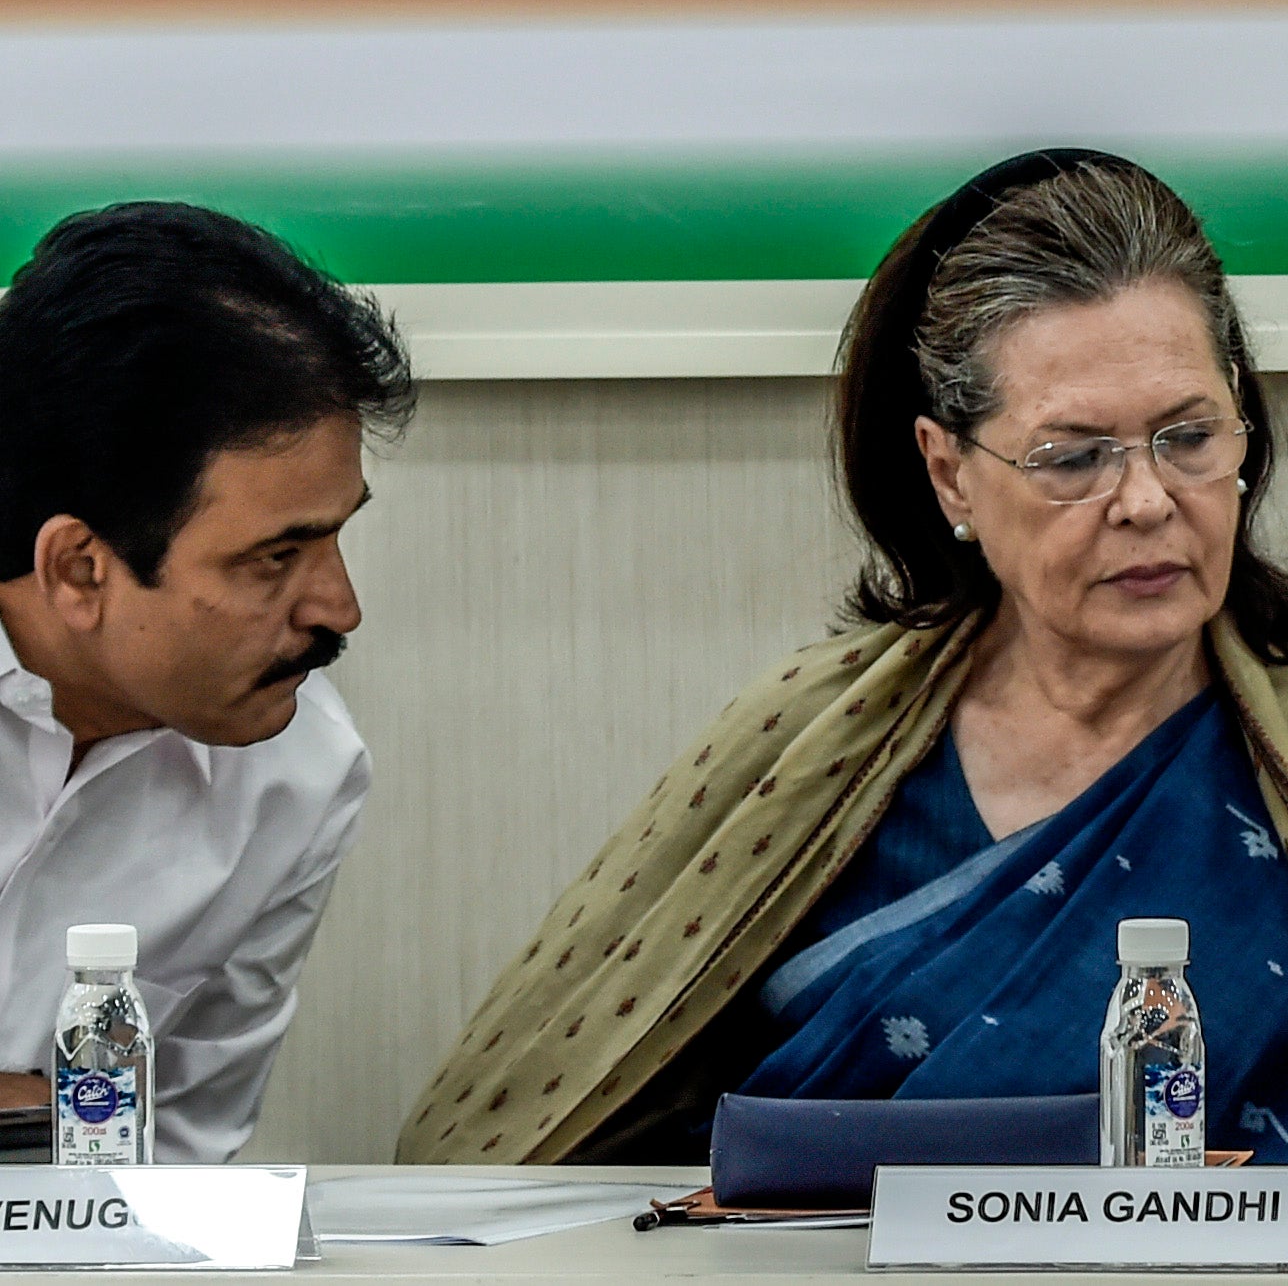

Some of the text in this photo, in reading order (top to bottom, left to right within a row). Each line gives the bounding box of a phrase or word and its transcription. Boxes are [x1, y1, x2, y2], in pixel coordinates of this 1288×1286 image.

[0, 1198, 140, 1231] ENUG
[946, 1190, 1281, 1224] SONIA GANDHI
